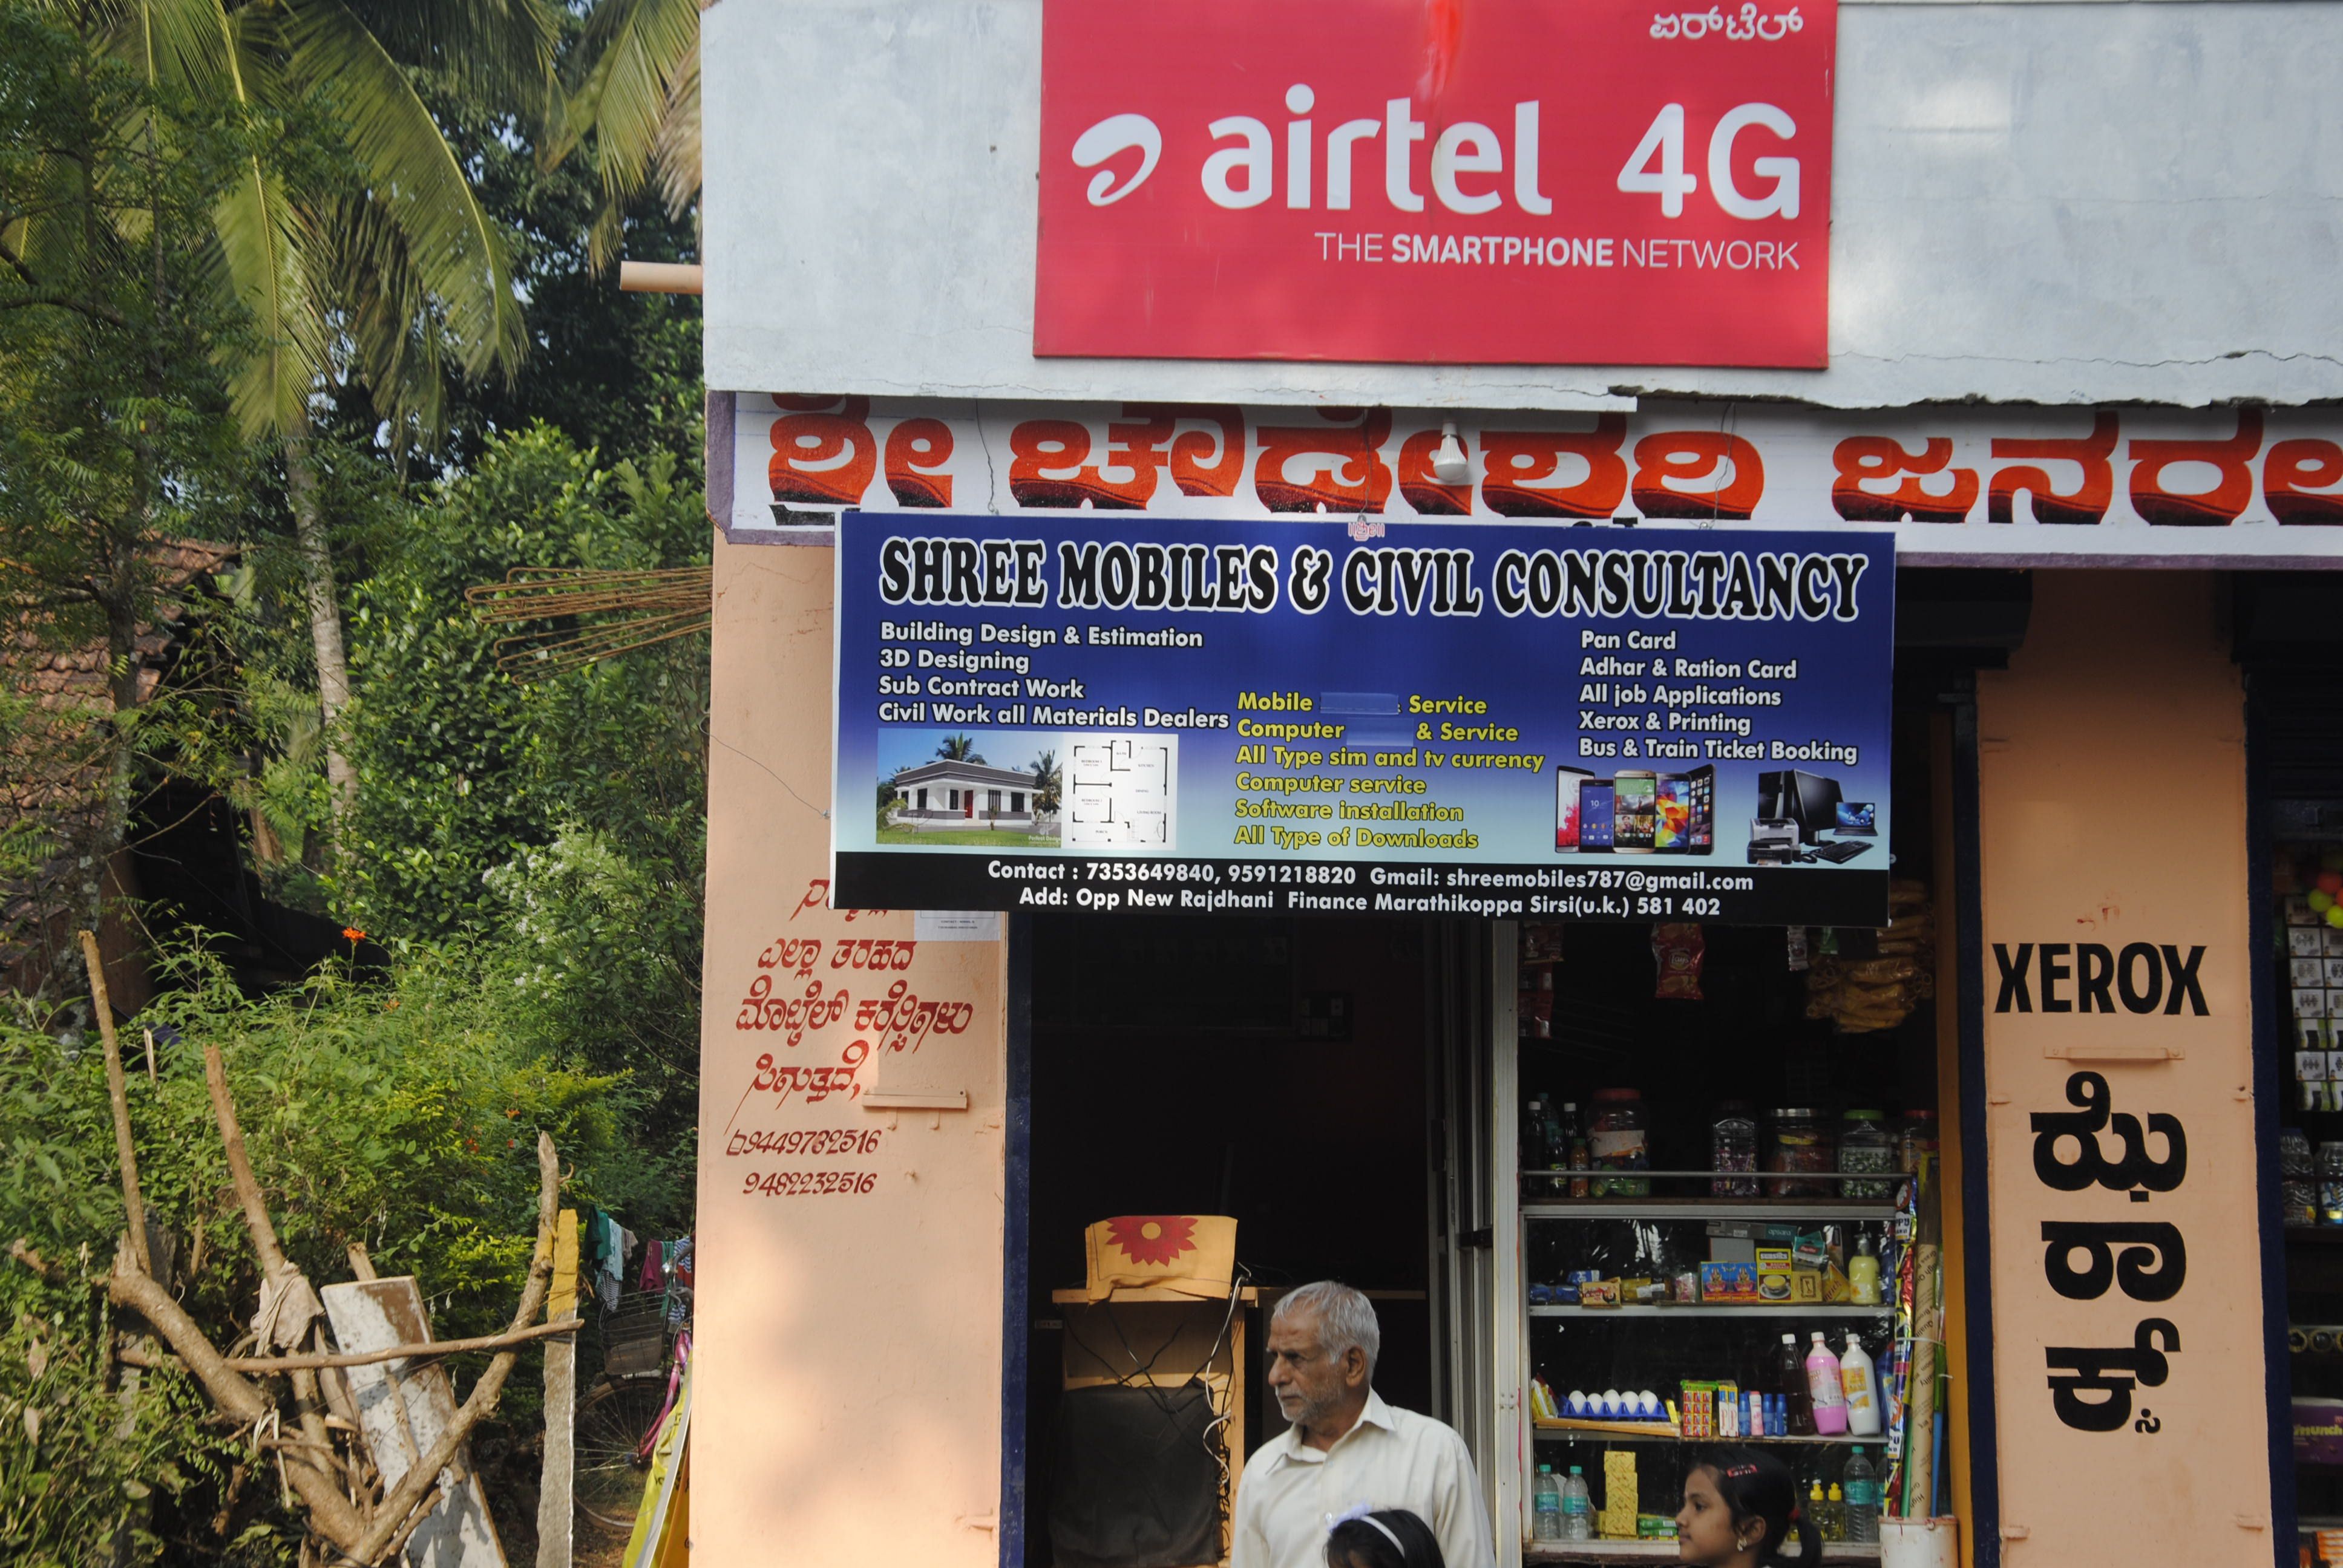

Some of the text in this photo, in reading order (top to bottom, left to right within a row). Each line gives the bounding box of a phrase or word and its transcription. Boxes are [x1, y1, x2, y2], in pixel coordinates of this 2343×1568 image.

[1201, 83, 1800, 220] airtel 4G
[1314, 232, 1799, 270] THE SMARTPHONE NETWORK
[879, 536, 1869, 622] SHREE MOBILES & CIVIL CONSULTANCY
[882, 621, 1202, 647] Building Design & Estimation
[1582, 630, 1676, 649] Pan Card
[880, 648, 1029, 674] 3D Designing
[1581, 656, 1796, 678] Adhar & Ration Card
[879, 675, 1084, 698] Sub Contract Work
[1580, 684, 1781, 708] All job Applications
[879, 702, 1228, 728] Civil Work all Materials Dealers
[1238, 691, 1487, 714] Mobile Service
[1237, 719, 1518, 742] Computer & Service
[1579, 711, 1750, 736] Xerox & Printing
[1236, 745, 1544, 773] All Type sim and tv currency
[1580, 738, 1856, 765] Bus & Train Ticket Booking
[1236, 772, 1426, 795] Computer service
[1236, 799, 1463, 820] Software installation
[1235, 826, 1478, 849] All Type of Downloads
[988, 860, 1065, 880] Contact
[1228, 864, 1355, 884] 9591218820
[1370, 867, 1439, 886] Gmail:
[1447, 867, 1753, 892] shreemobiles787@gmail.com
[1019, 886, 1720, 918] Add: Opp New Rajdhani Finance Marathikoppa Sirsi(u.k.) 581 402
[1991, 942, 2210, 1016] XEROX
[743, 1172, 877, 1196] 9482232516
[1768, 1228, 1792, 1236] apsara
